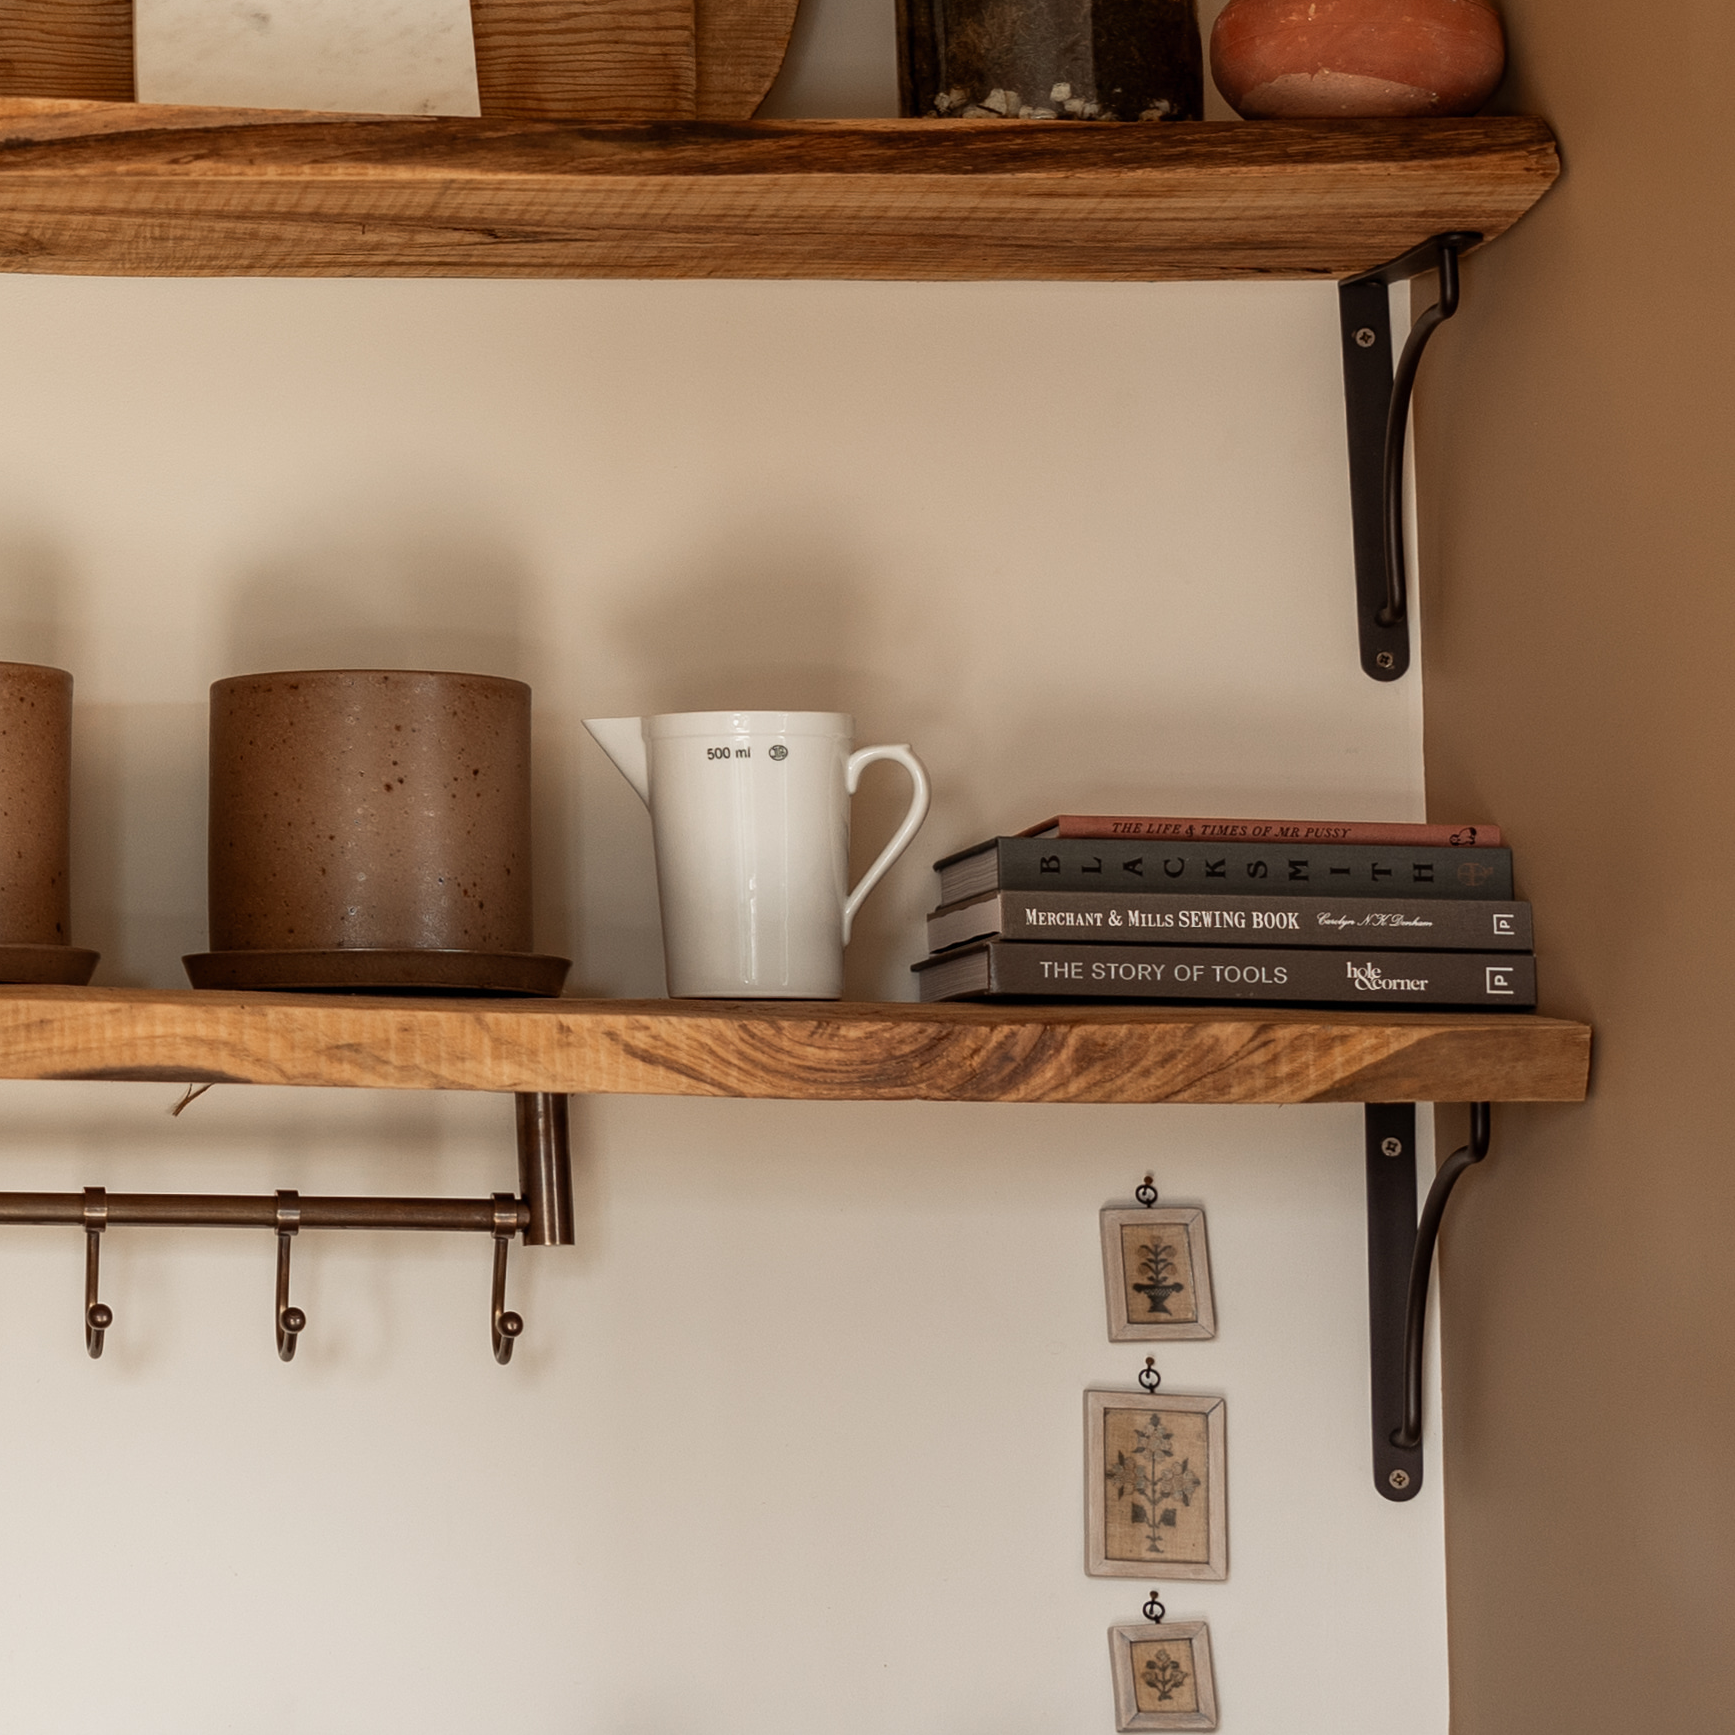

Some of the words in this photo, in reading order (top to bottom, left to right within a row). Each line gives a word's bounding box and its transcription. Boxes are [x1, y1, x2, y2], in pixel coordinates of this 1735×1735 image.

[707, 747, 730, 760] 500
[735, 747, 750, 758] ml
[1112, 823, 1143, 834] THE
[1146, 824, 1182, 835] LIFE
[1185, 825, 1197, 837] &
[1201, 826, 1248, 837] TIMES
[1252, 827, 1273, 837] OF
[1274, 827, 1299, 837] MR
[1305, 828, 1351, 838] PUSSY
[1041, 855, 1434, 883] BLACKSMITH
[1025, 909, 1103, 926] MERCHANT
[1108, 910, 1122, 926] &
[1127, 910, 1174, 927] MILLS
[1179, 912, 1245, 928] SEWING
[1251, 912, 1300, 929] BOOK
[1317, 912, 1355, 930] Carolyn
[1389, 914, 1433, 927] Denham
[1040, 962, 1083, 978] THE
[1091, 963, 1165, 980] STORY
[1174, 964, 1205, 981] OF
[1212, 966, 1287, 984] TOOLS
[1346, 962, 1382, 979] hole
